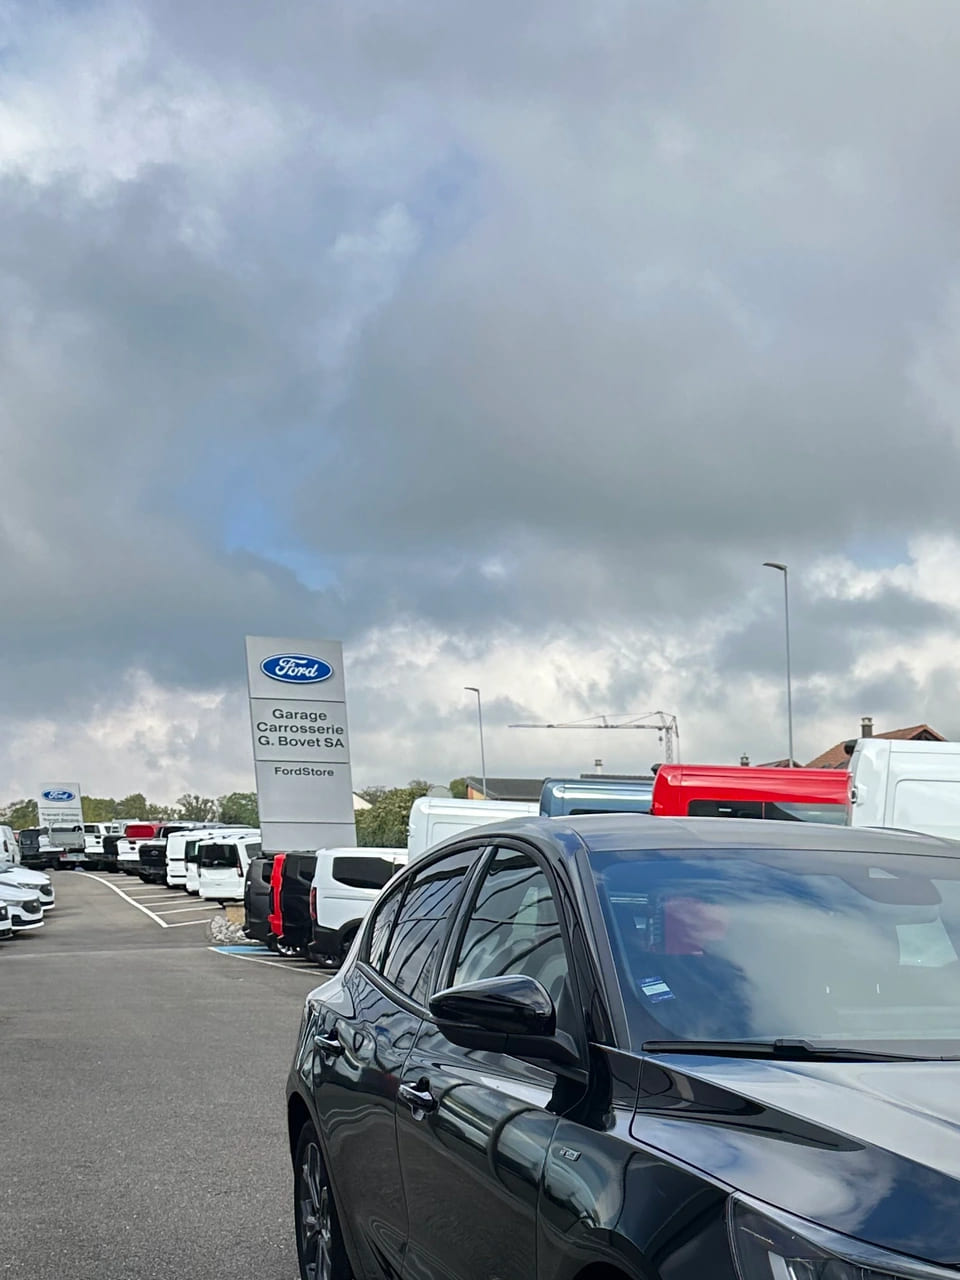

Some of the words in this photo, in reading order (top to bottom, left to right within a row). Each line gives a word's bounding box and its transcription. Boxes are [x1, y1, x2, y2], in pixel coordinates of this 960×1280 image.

[274, 657, 319, 677] Ford
[272, 708, 327, 722] Garage
[256, 722, 344, 735] Carrosserie
[258, 735, 275, 746] G.
[278, 736, 321, 748] Bovet
[324, 737, 345, 748] SA
[274, 767, 335, 777] FordStore
